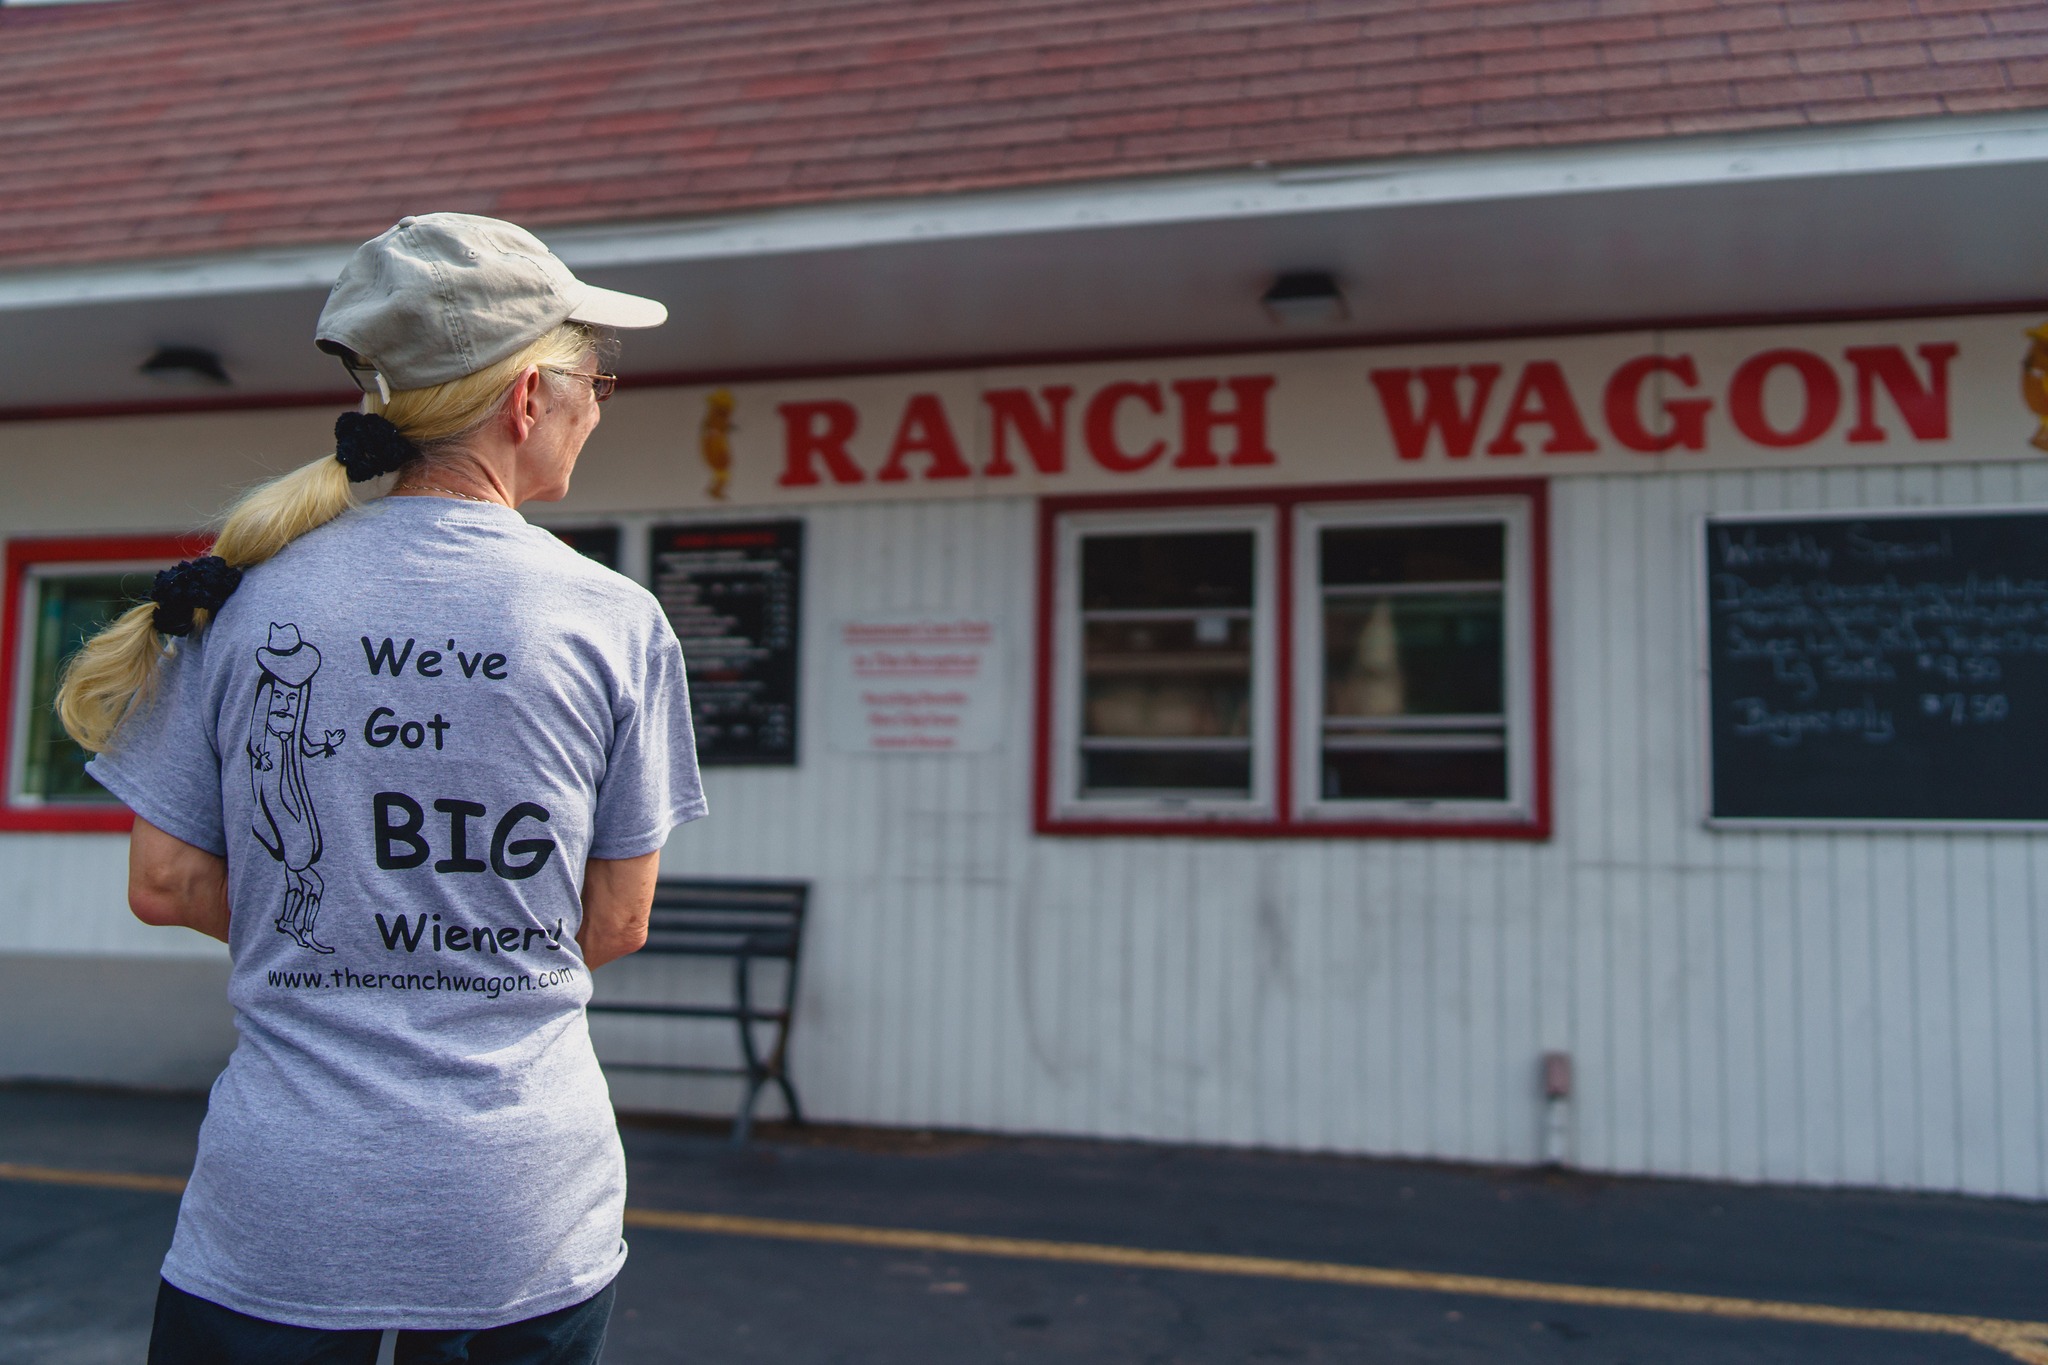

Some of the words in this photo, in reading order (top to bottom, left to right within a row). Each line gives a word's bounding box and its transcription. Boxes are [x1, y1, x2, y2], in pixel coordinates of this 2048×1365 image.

[780, 378, 1273, 486] RANCH
[1372, 346, 1955, 460] WAGON
[361, 636, 507, 680] We've
[364, 707, 450, 750] Got
[373, 792, 556, 880] BIG
[268, 966, 574, 999] www.theranchwagon.com
